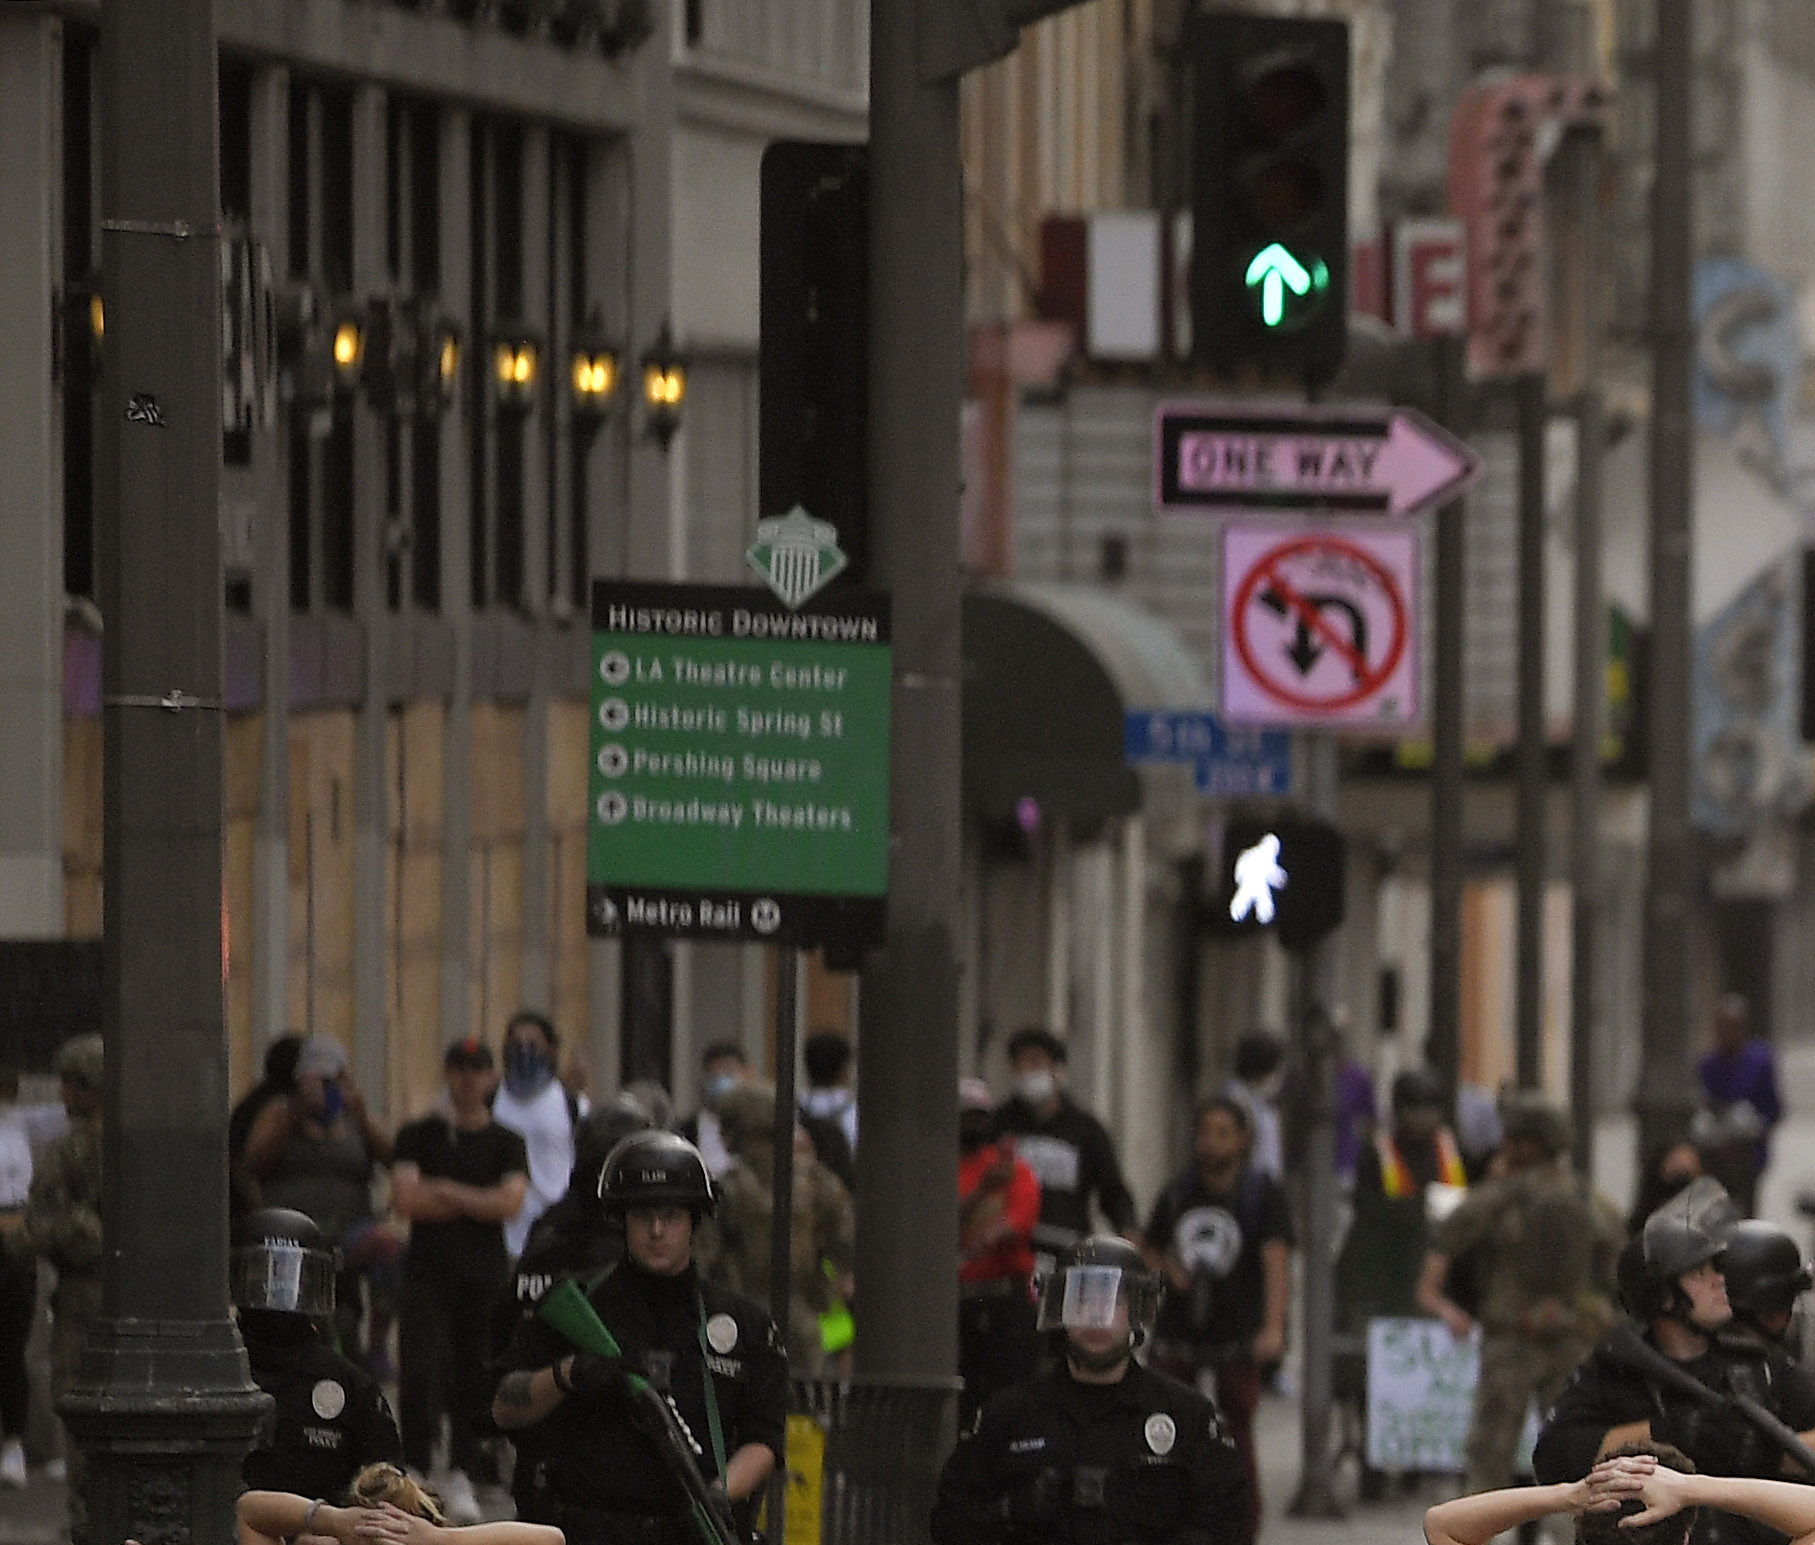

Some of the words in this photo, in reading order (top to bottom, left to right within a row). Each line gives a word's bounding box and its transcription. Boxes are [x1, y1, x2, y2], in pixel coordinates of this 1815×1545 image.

[1191, 438, 1268, 484] ONE
[1297, 442, 1378, 486] WAY
[635, 656, 663, 683] LA
[769, 660, 847, 690] Center
[634, 701, 727, 732] Historic
[737, 706, 811, 740] Spring
[820, 710, 843, 738] St
[633, 747, 735, 783] Pershing
[743, 752, 822, 784] Square
[633, 796, 742, 831] Broadway
[627, 895, 692, 927] Metro
[699, 899, 740, 929] Rail
